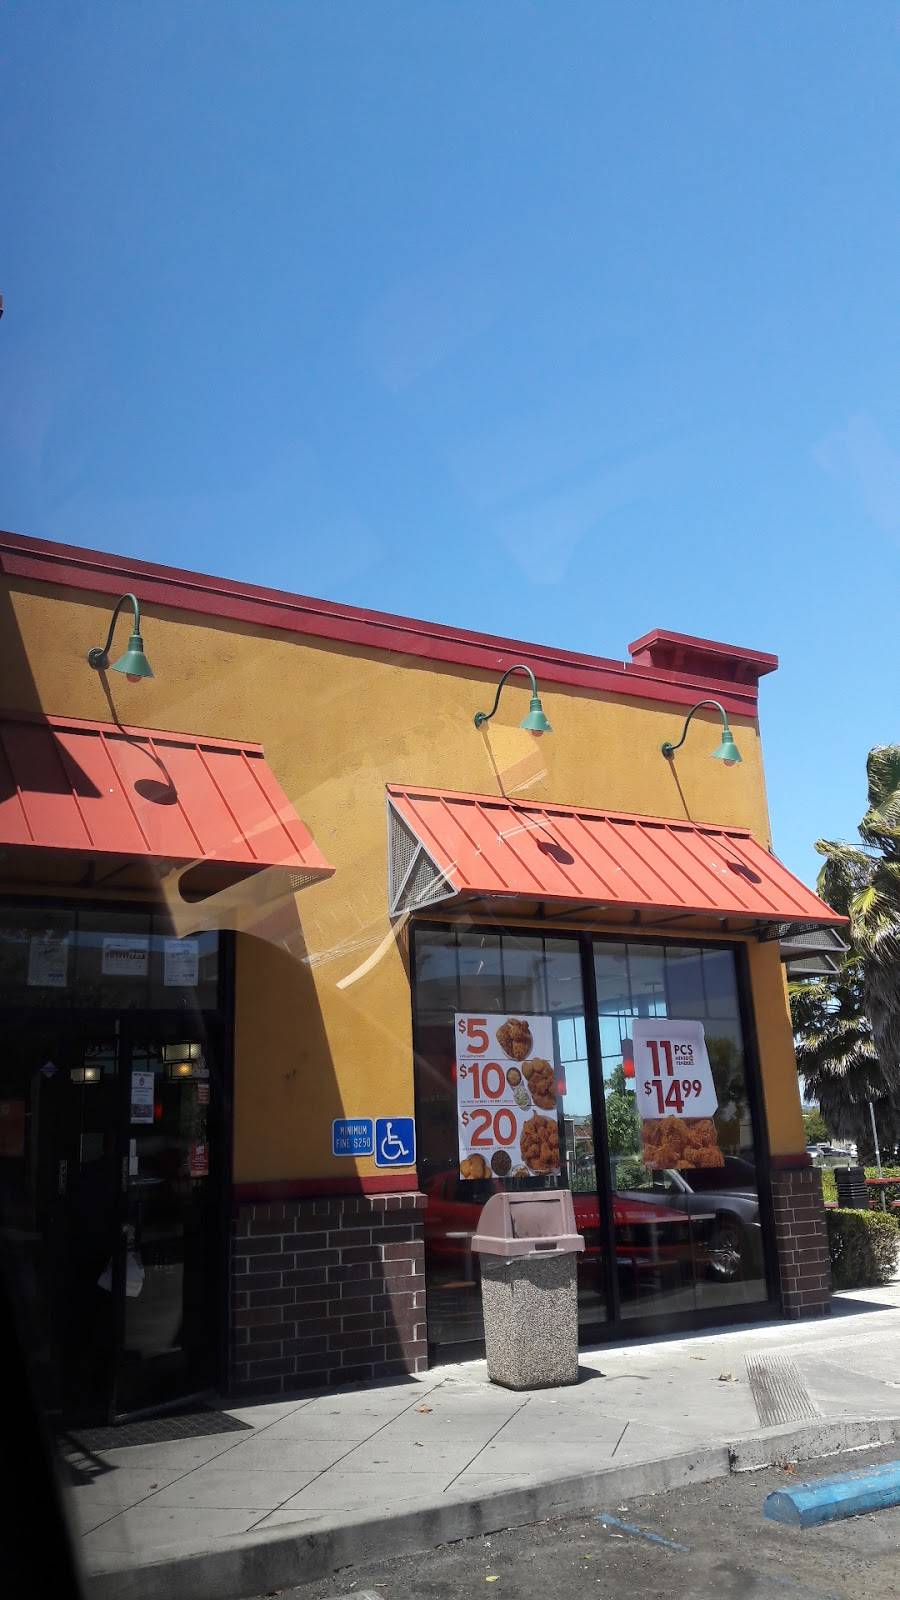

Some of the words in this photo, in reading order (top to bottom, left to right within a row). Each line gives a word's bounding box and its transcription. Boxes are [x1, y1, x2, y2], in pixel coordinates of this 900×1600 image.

[458, 1018, 489, 1054] $5
[646, 1041, 674, 1077] 11
[674, 1044, 693, 1055] PCS
[459, 1062, 506, 1099] $10
[336, 1138, 350, 1149] FINE
[353, 1137, 371, 1149] $250
[340, 1125, 368, 1135] MINIMUM
[461, 1108, 517, 1146] $20
